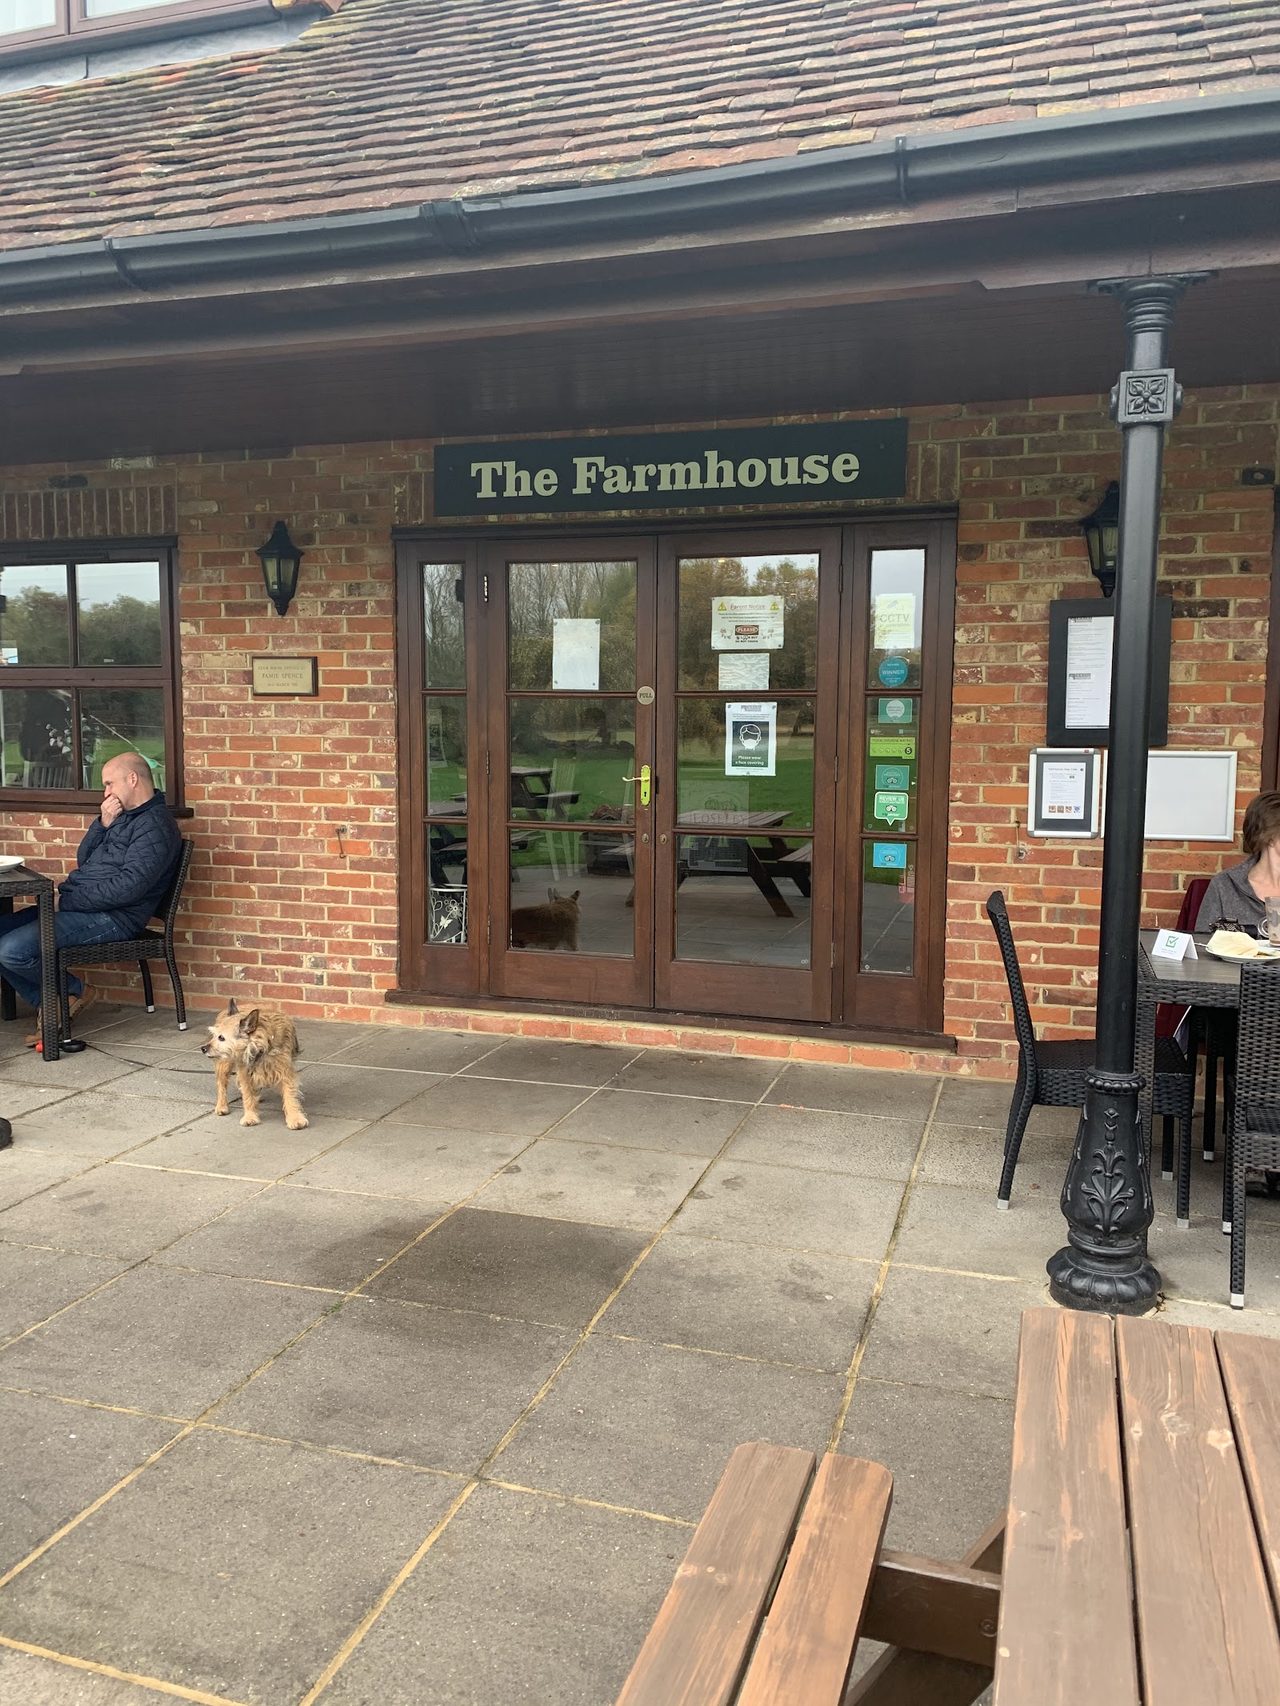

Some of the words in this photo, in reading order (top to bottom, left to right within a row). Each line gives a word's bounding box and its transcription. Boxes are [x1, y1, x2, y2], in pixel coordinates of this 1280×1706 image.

[470, 461, 559, 499] The
[571, 449, 861, 495] Farmhouse
[879, 613, 910, 623] CCTV
